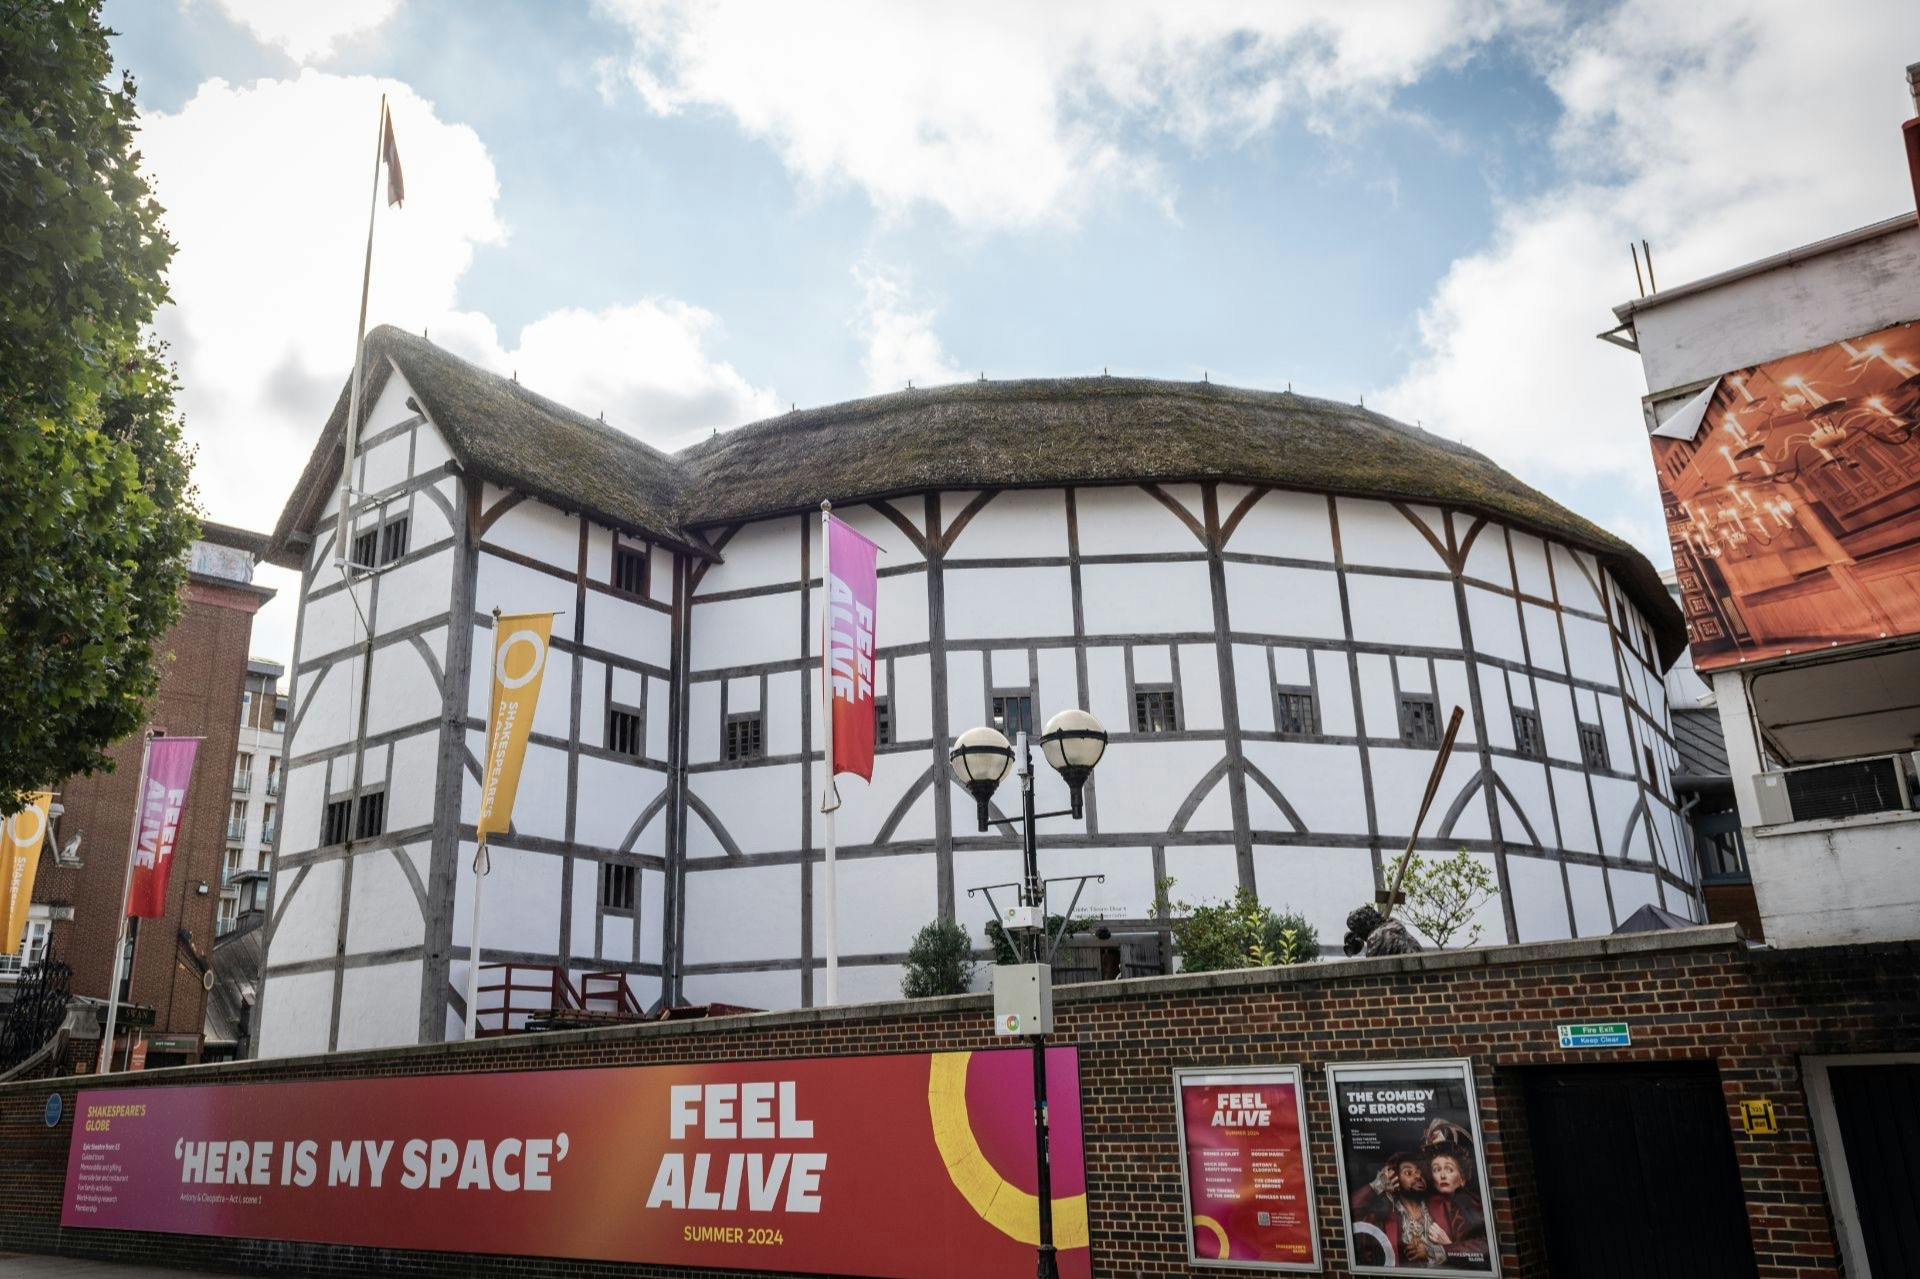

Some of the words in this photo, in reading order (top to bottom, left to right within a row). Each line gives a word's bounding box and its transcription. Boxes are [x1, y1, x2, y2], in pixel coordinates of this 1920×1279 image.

[830, 572, 854, 705] ALIVE
[855, 601, 873, 700] FEEL
[483, 702, 518, 818] SHAKESPEARE'S
[136, 778, 165, 870] ALIVE
[159, 789, 184, 863] FEEL
[1217, 1093, 1267, 1109] FEEL
[1347, 1092, 1373, 1102] THE
[1376, 1089, 1434, 1102] COMEDY
[1348, 1104, 1366, 1115] OF
[1369, 1102, 1425, 1114] ERRORS
[88, 1104, 146, 1118] SHAKESPEARE'S
[670, 1081, 814, 1139] FEEL
[1211, 1110, 1271, 1127] ALIVE
[1745, 1103, 1772, 1130] H
[85, 1120, 111, 1132] GLOBE
[280, 1140, 319, 1188] IS
[328, 1139, 395, 1188] MY
[645, 1153, 828, 1213] ALIVE
[242, 1197, 258, 1205] scene
[684, 1225, 743, 1243] SUMMER
[747, 1228, 784, 1245] 2024
